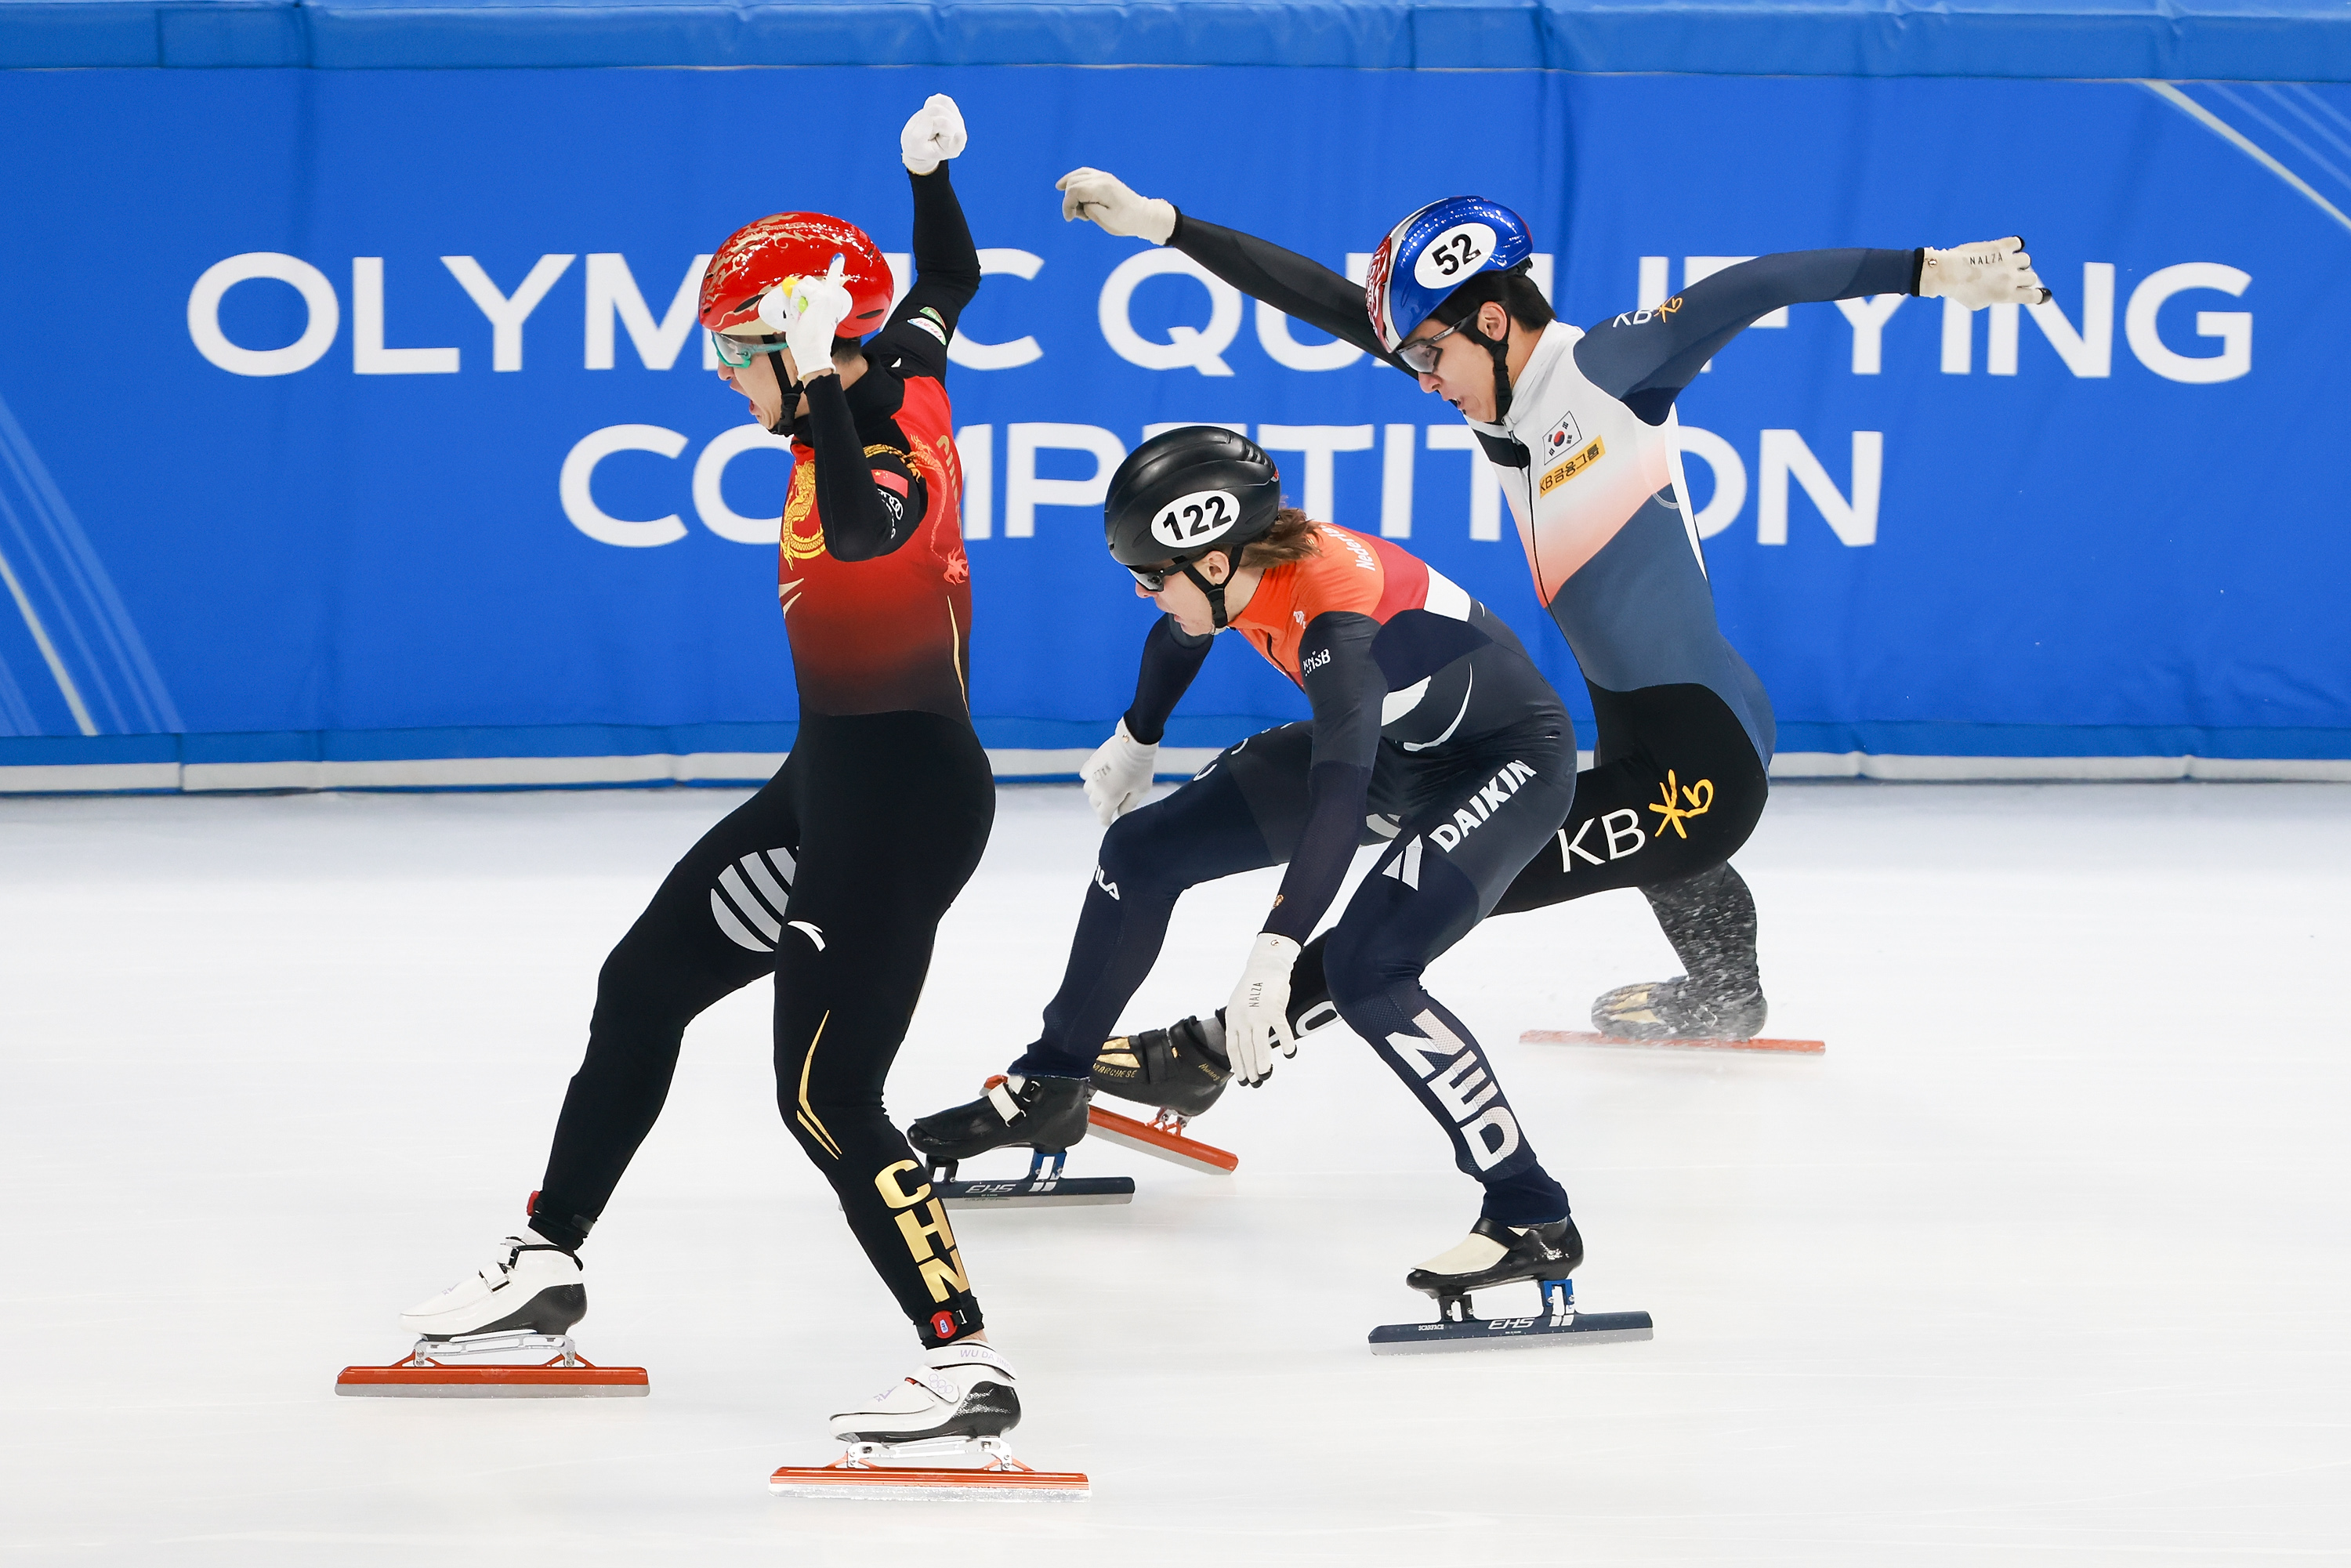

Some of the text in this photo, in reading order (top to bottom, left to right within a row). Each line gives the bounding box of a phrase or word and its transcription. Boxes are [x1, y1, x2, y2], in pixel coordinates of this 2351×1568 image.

[1432, 234, 1481, 276] 52
[1970, 252, 2004, 265] NALZA
[187, 248, 1044, 376] OLYMC
[1163, 496, 1232, 541] 122
[1428, 759, 1537, 853] DAIKIN
[1557, 808, 1646, 873] KB
[1249, 982, 1263, 1007] NALZA
[1385, 1008, 1520, 1172] NED
[965, 1183, 1017, 1193] EHS
[874, 1159, 971, 1304] CHN
[1488, 1317, 1535, 1330] EHS
[960, 1349, 979, 1358] WU
[981, 1351, 994, 1360] DA
